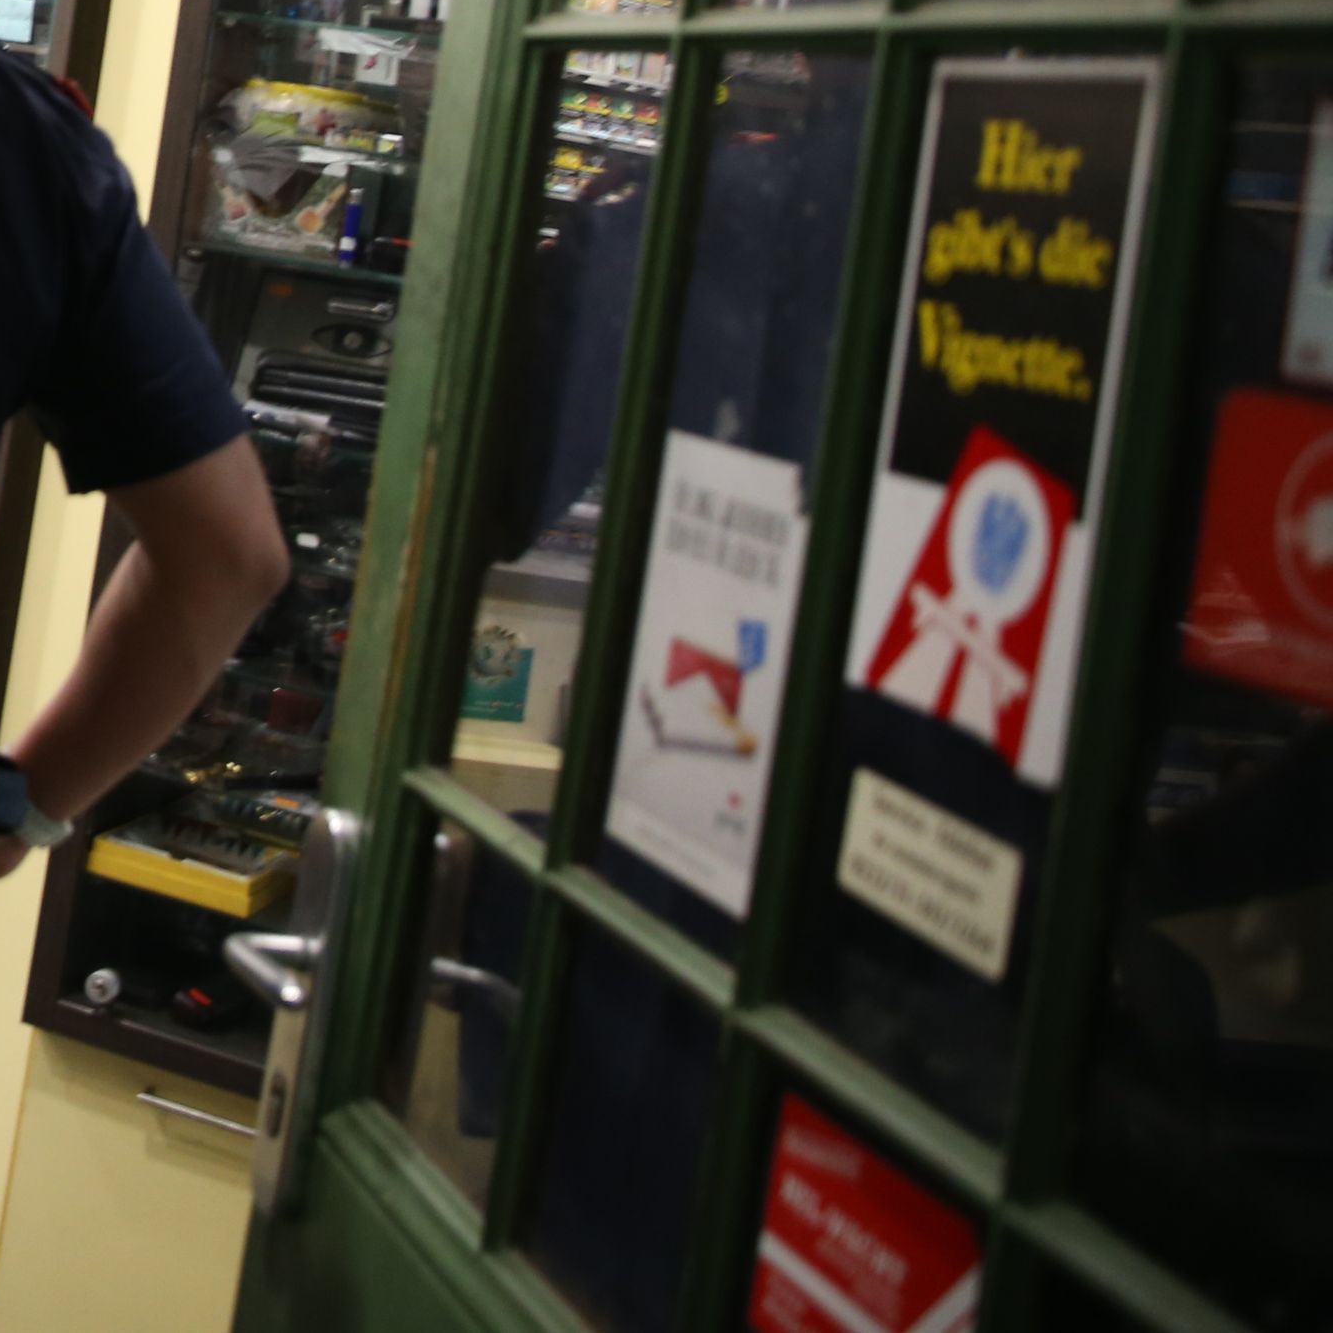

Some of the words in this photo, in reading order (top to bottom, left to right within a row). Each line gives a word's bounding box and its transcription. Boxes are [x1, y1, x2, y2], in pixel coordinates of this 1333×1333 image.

[975, 118, 1083, 196] Hier
[923, 209, 1033, 284] gibt's
[1038, 218, 1113, 290] die
[917, 298, 1092, 403] Vignette.
